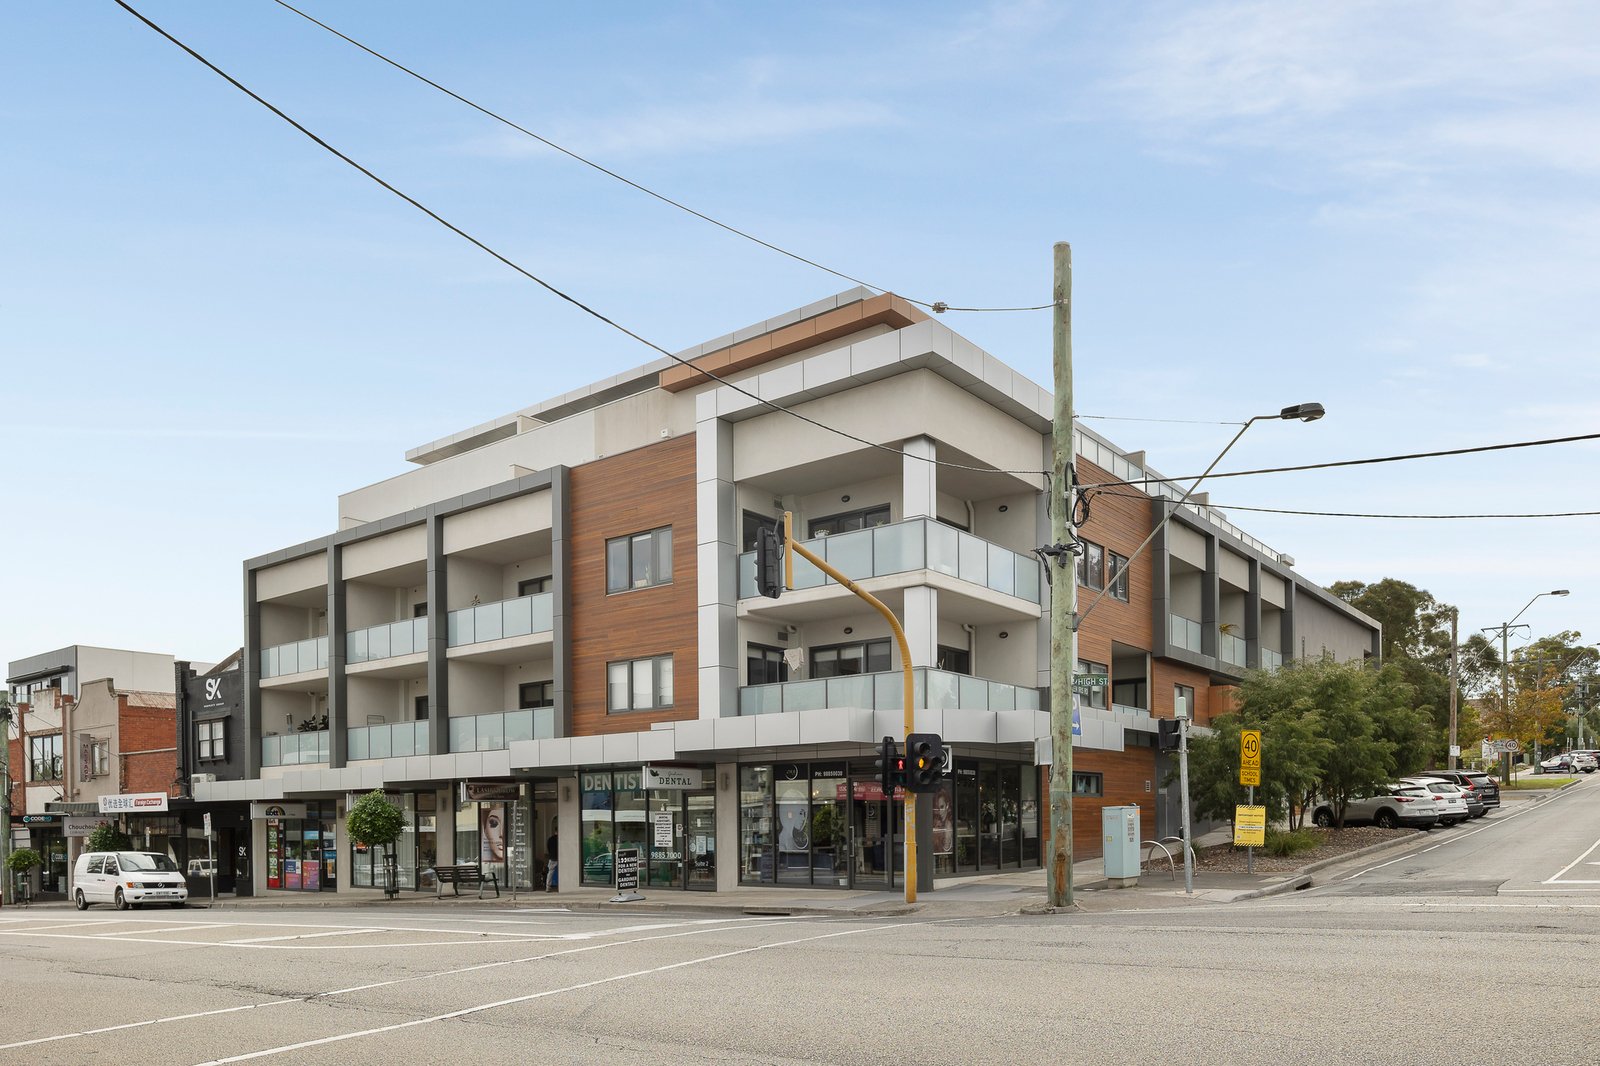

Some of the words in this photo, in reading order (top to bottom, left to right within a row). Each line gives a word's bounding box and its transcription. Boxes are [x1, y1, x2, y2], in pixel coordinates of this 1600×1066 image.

[1078, 677, 1096, 685] HIGH
[1098, 677, 1108, 685] ST
[205, 677, 222, 701] SK
[1244, 739, 1257, 752] 40
[1242, 759, 1259, 767] AHEAD
[658, 776, 692, 786] DENTAL
[666, 851, 682, 859] 7000
